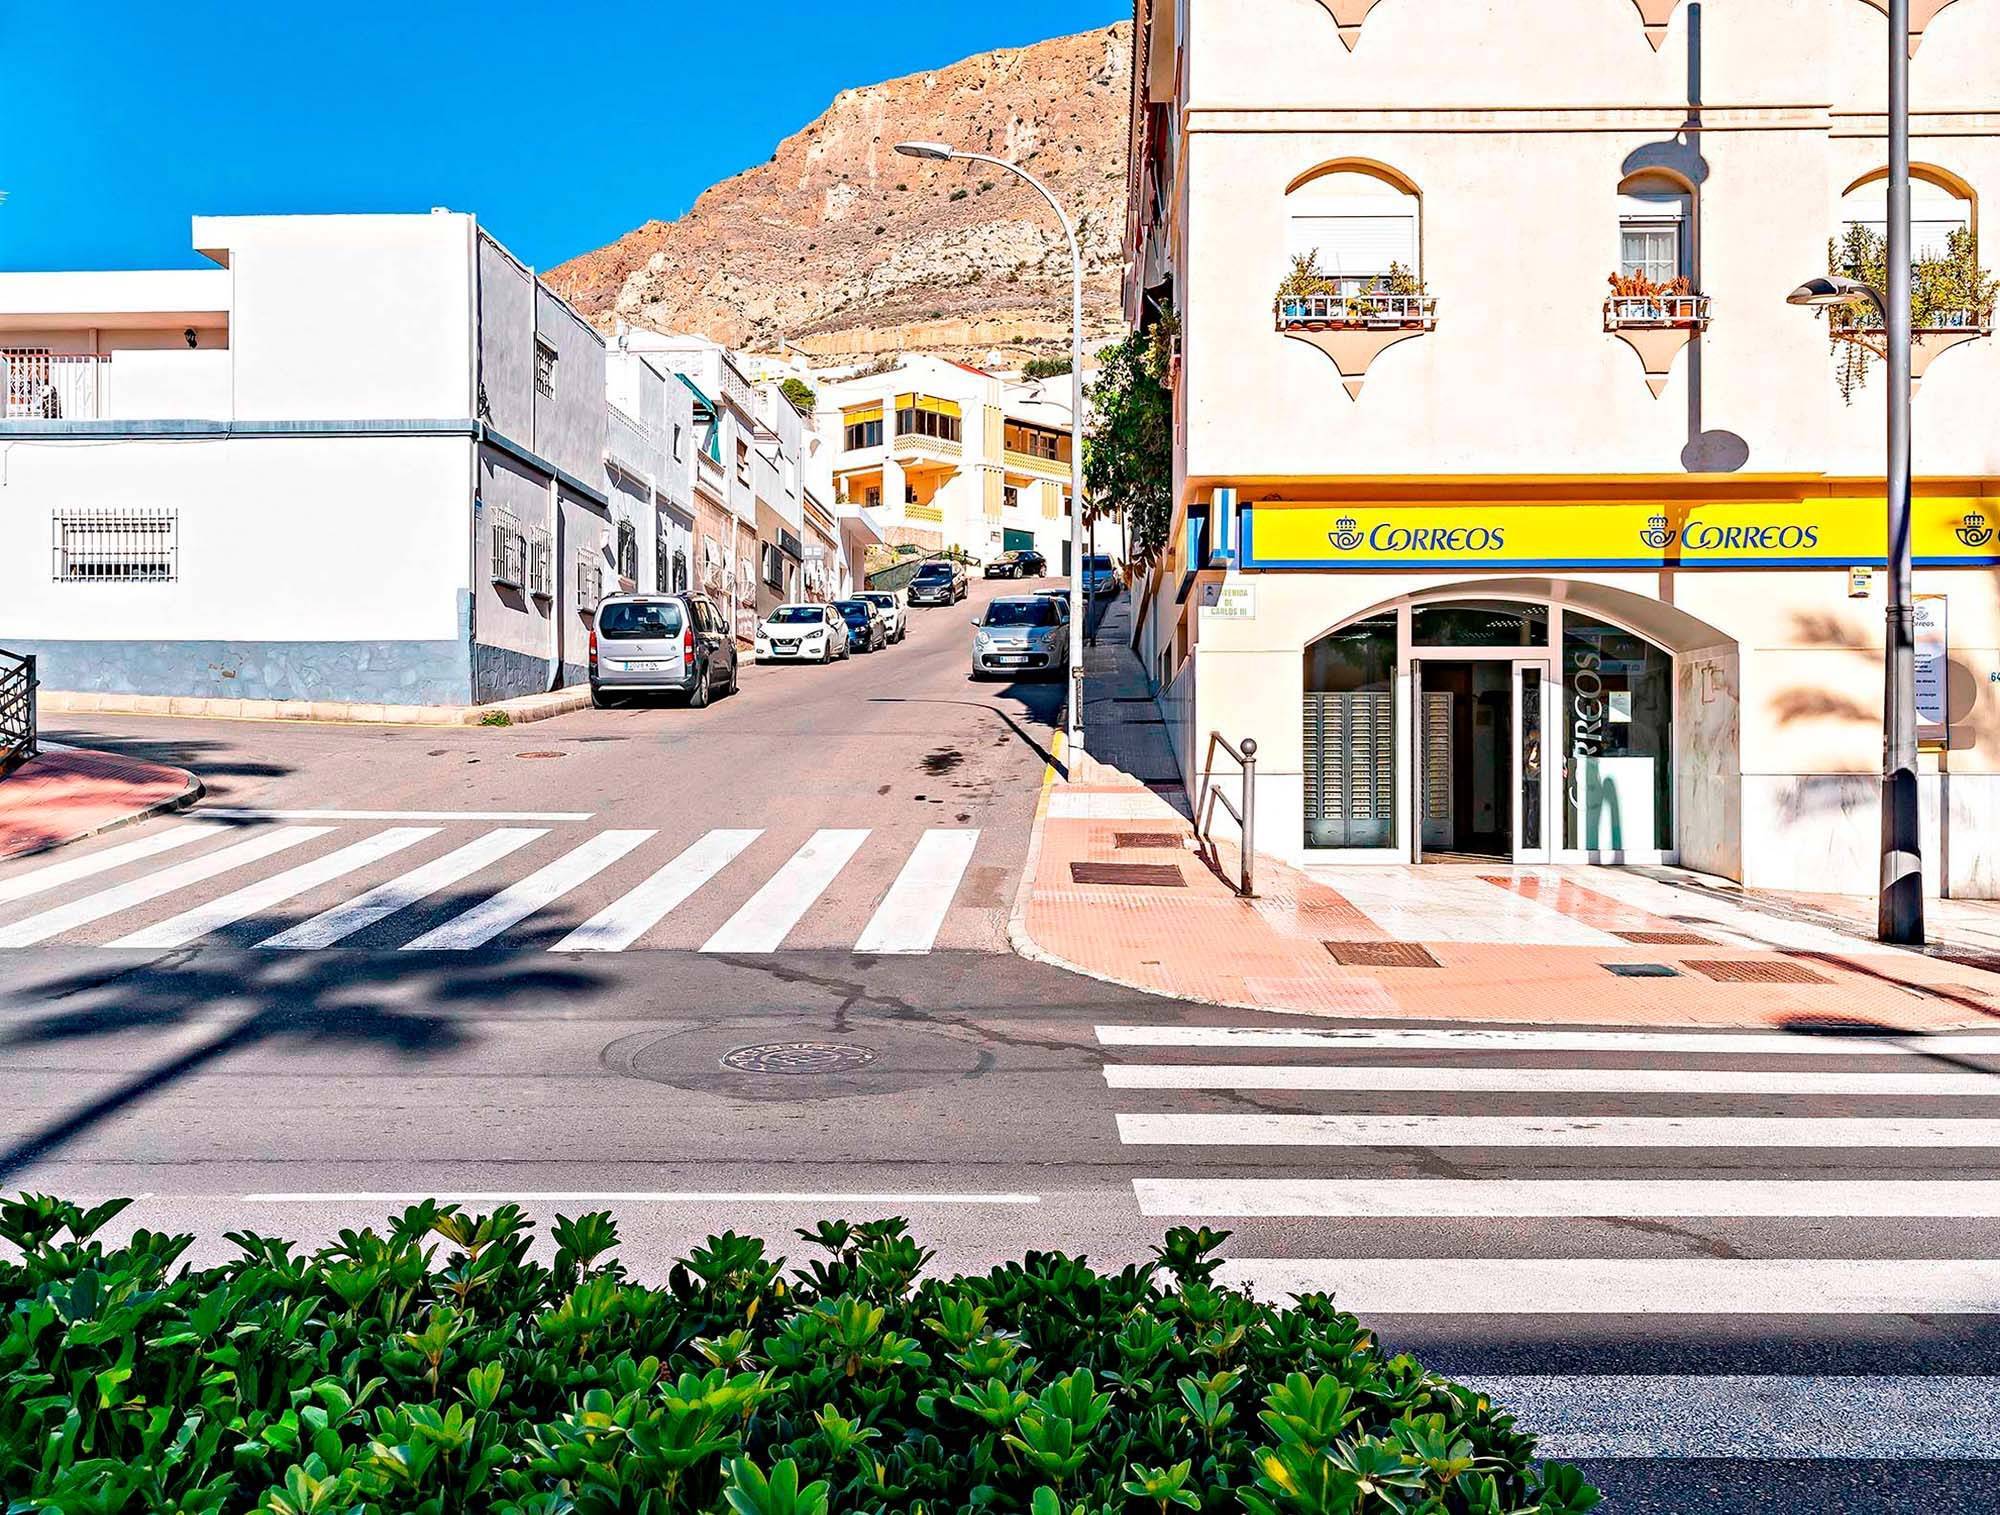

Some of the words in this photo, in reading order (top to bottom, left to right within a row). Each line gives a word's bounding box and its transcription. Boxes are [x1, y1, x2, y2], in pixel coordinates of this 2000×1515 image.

[1369, 523, 1505, 551] CORREOS
[1681, 521, 1819, 549] CORREOS
[1210, 607, 1238, 616] CARLOS
